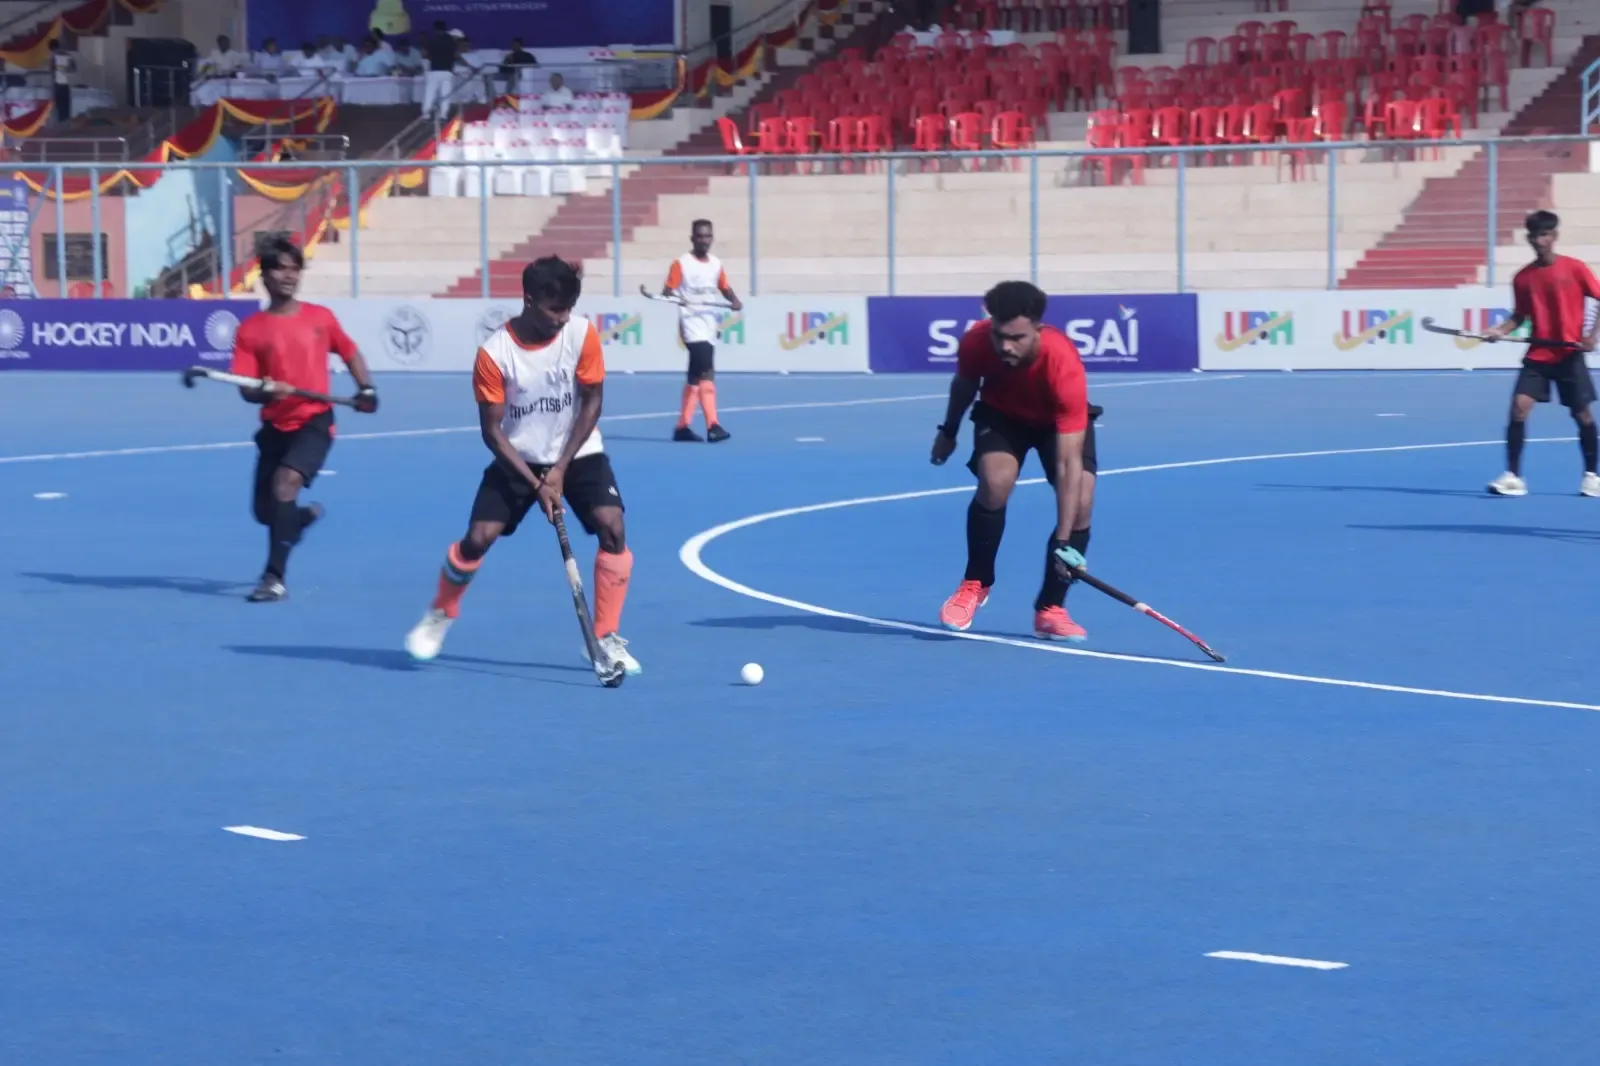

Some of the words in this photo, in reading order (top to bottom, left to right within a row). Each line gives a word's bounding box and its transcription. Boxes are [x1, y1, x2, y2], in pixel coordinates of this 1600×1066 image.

[32, 321, 126, 347] HOCKEY
[130, 322, 196, 347] INDIA
[787, 311, 848, 346] UPH
[1065, 318, 1139, 356] SAI
[1223, 310, 1295, 347] UPH
[1341, 309, 1414, 345] UPH
